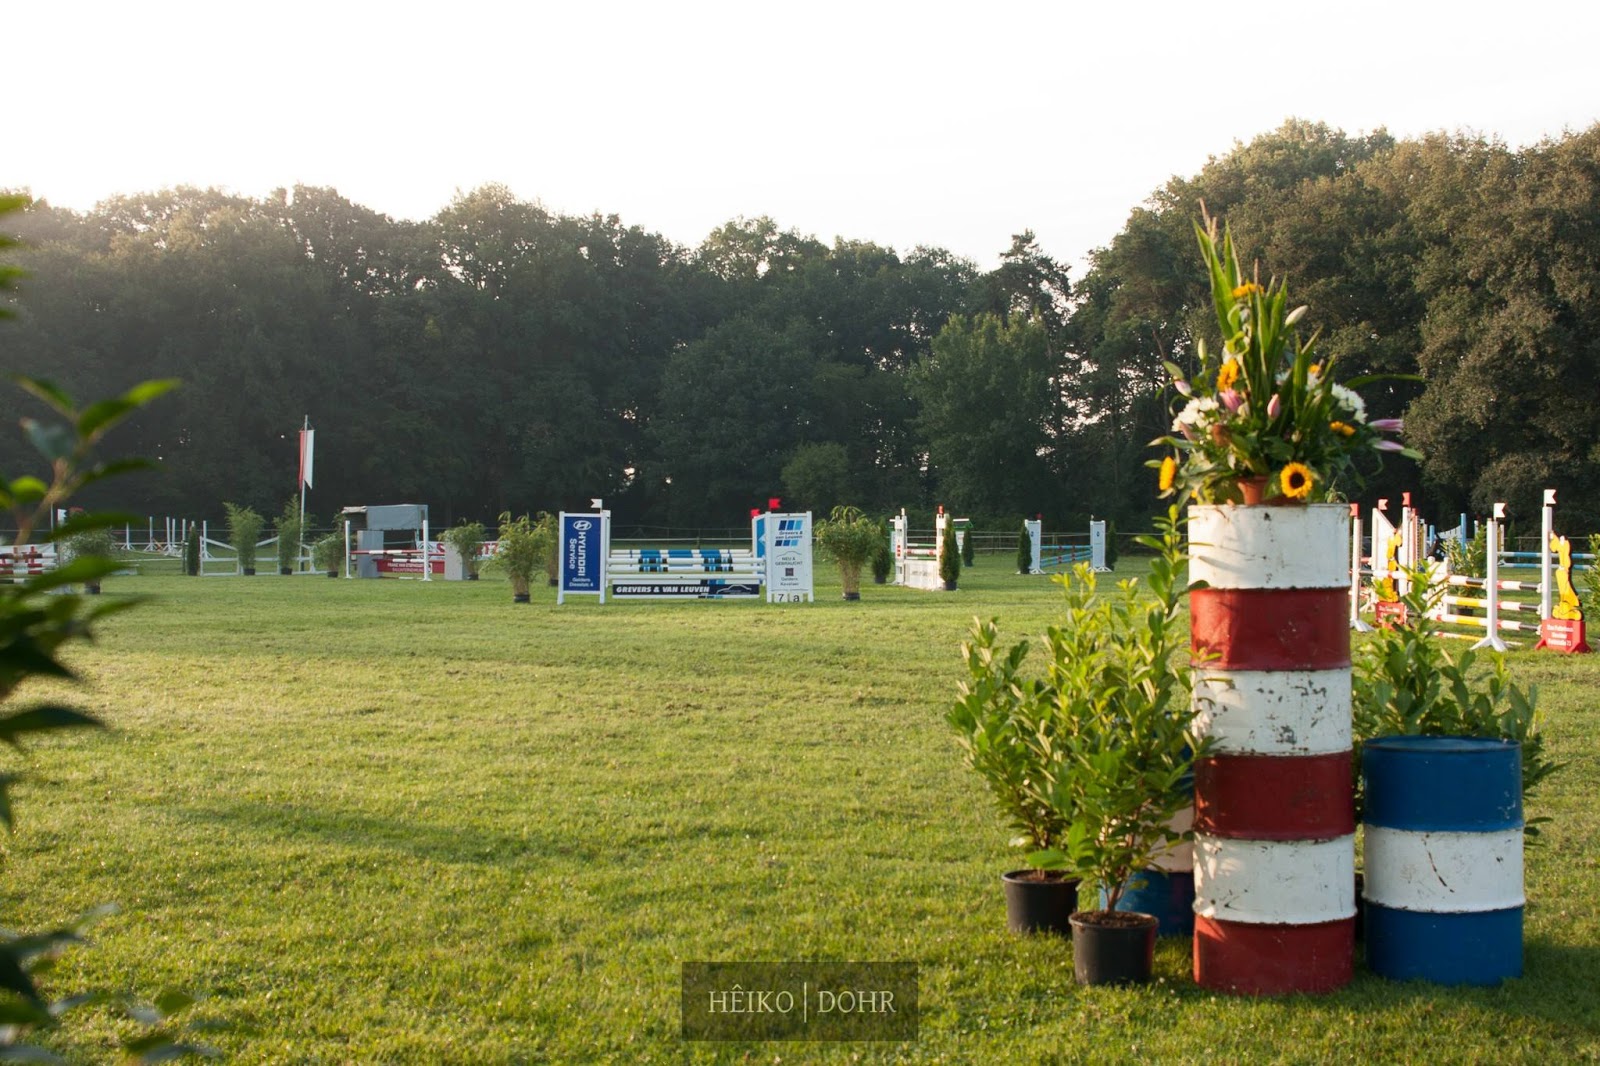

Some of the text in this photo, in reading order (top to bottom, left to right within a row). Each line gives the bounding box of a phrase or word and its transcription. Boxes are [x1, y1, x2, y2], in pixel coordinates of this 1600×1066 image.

[569, 538, 577, 570] Service
[578, 532, 586, 576] HYUNDAI
[778, 593, 800, 602] 7 a
